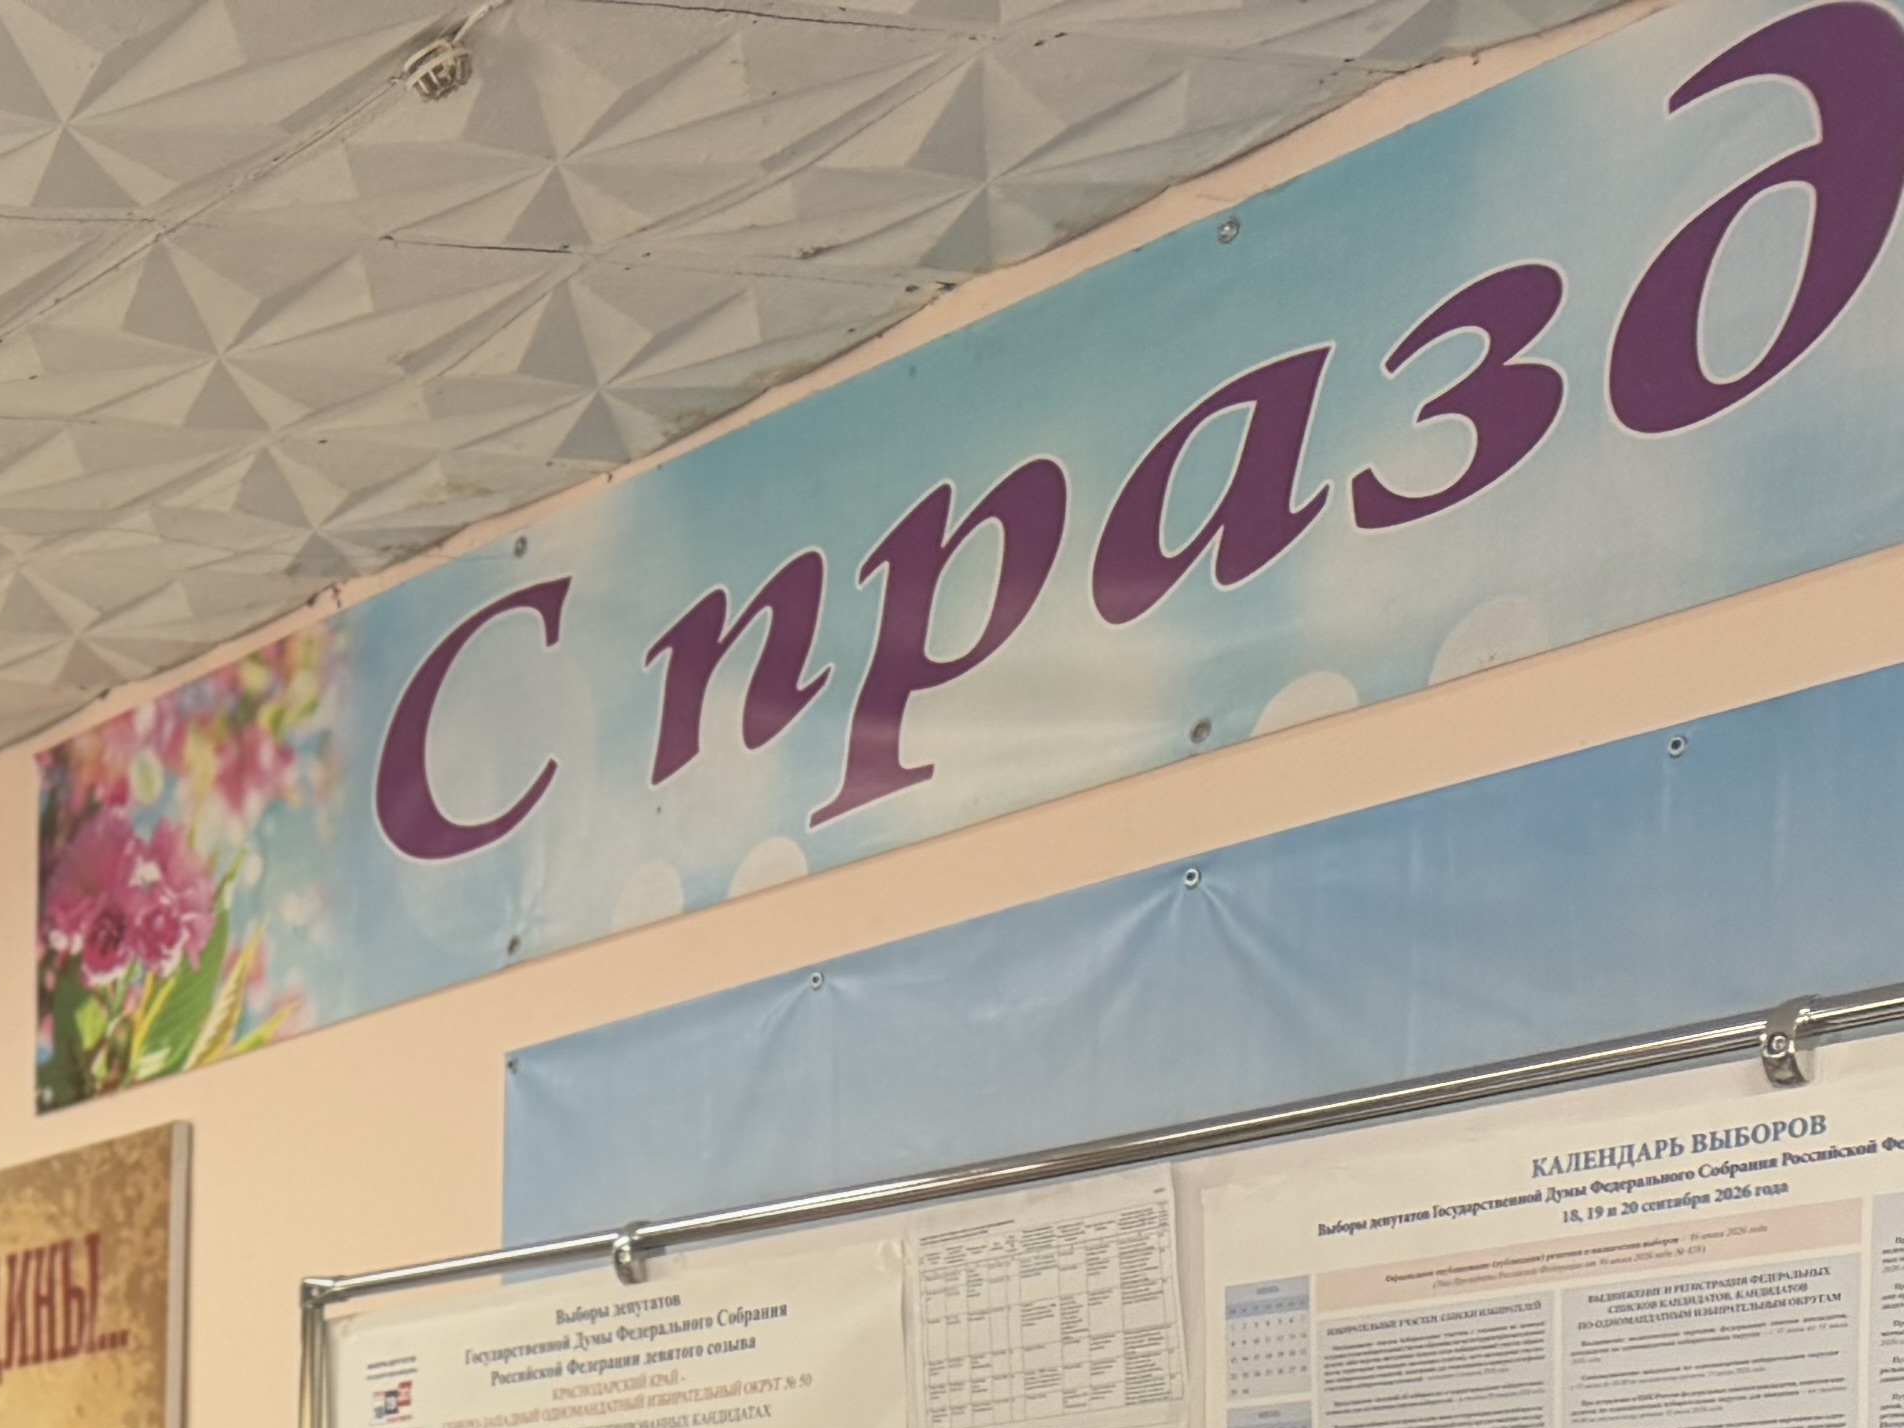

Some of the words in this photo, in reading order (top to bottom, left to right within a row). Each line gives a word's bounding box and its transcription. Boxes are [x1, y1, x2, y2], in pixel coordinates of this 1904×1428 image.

[373, 575, 575, 862] С
[1531, 1136, 1685, 1178] КАЛЕНДАРЬ
[1691, 1114, 1828, 1154] ВЫБОРОВ
[1317, 1220, 1367, 1237] Выборы
[1369, 1210, 1430, 1230] депутатов
[1432, 1189, 1542, 1219] Государственной
[1545, 1185, 1587, 1205] Думы
[1590, 1169, 1695, 1194] Федерального
[1698, 1158, 1778, 1179] Собрания
[1781, 1140, 1878, 1166] Российской
[1562, 1208, 1583, 1224] 18,
[1588, 1205, 1604, 1220] 19
[1606, 1206, 1617, 1218] и
[1620, 1199, 1639, 1215] 20
[1641, 1192, 1710, 1213] сентября
[1714, 1184, 1752, 1202] 2026
[1755, 1181, 1789, 1197] года
[464, 1335, 570, 1366] Государственной
[574, 1329, 613, 1351] Думы
[616, 1315, 713, 1341] Федерального
[717, 1304, 788, 1327] Собрания
[555, 1306, 610, 1325] Выборы
[613, 1294, 681, 1317] депутатов
[491, 1362, 562, 1386] Российской
[566, 1354, 640, 1375] Федерации
[643, 1343, 704, 1365] девятого
[706, 1336, 756, 1356] созыва
[743, 1376, 782, 1395] ОКРУГ
